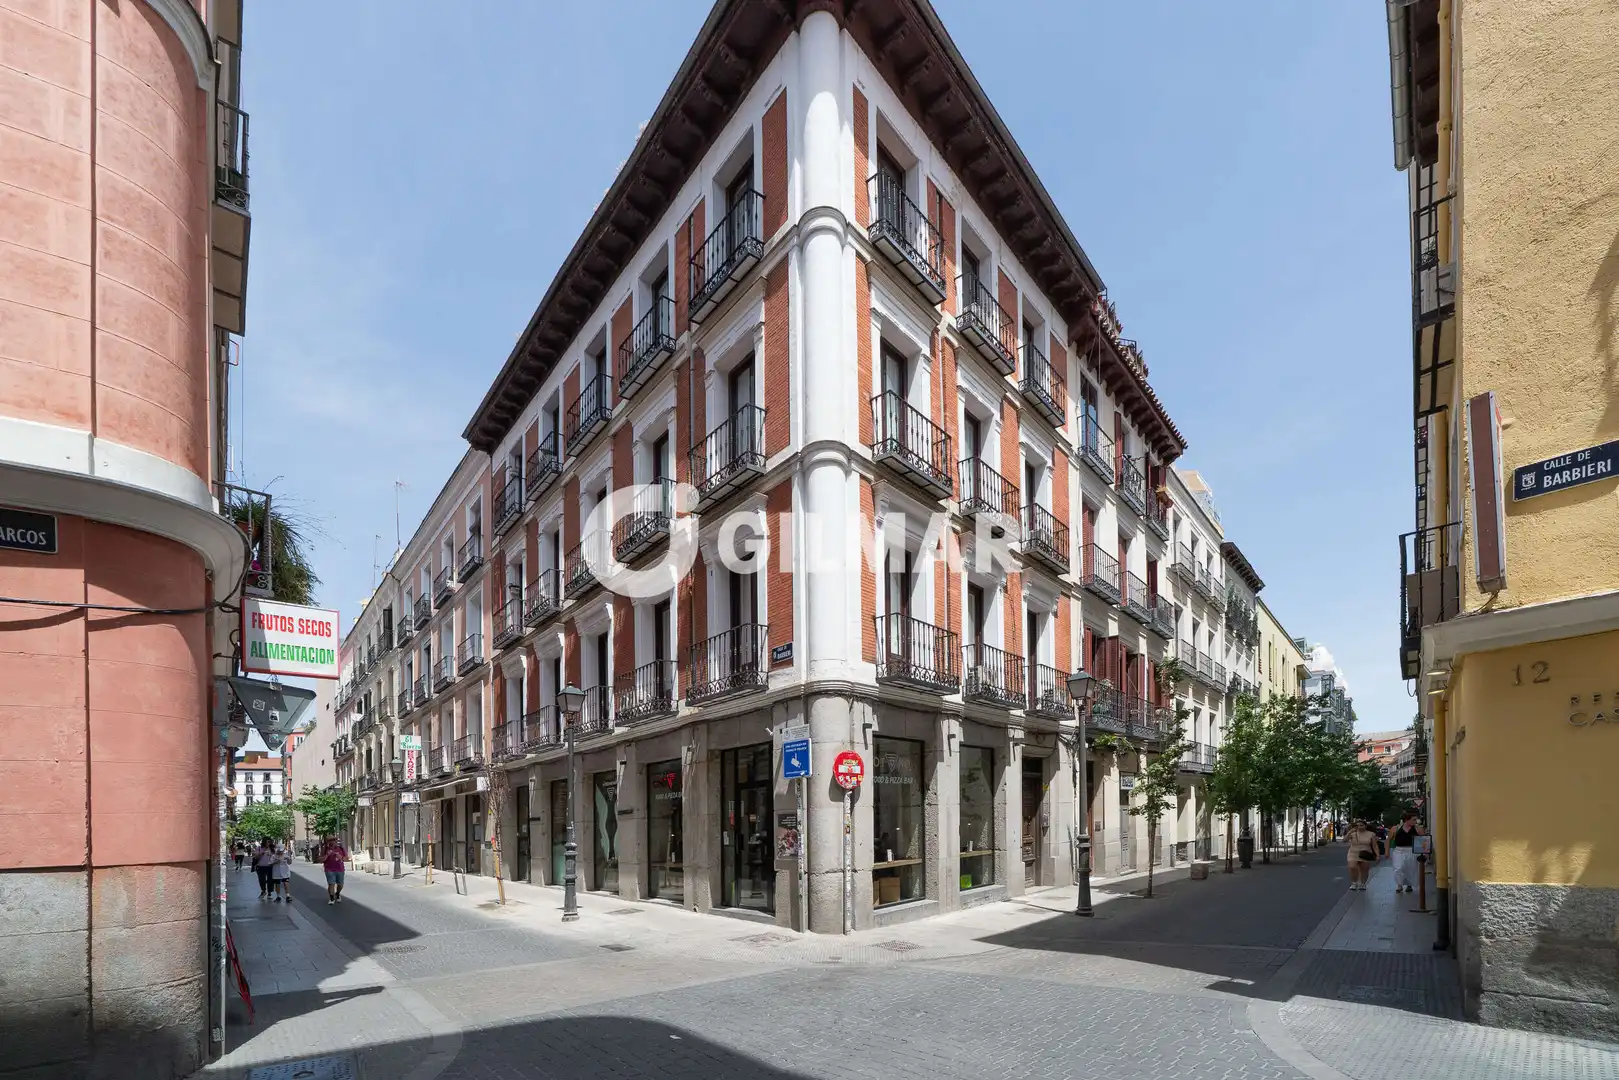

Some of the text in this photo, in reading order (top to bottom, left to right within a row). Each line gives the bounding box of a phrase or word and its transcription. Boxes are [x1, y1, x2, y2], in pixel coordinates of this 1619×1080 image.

[1543, 450, 1591, 471] CALLE DE
[1543, 459, 1612, 488] BARBIERI
[251, 611, 332, 638] FRUTOS SECOS
[250, 640, 335, 665] ALIMENTACION
[1512, 660, 1551, 686] 12
